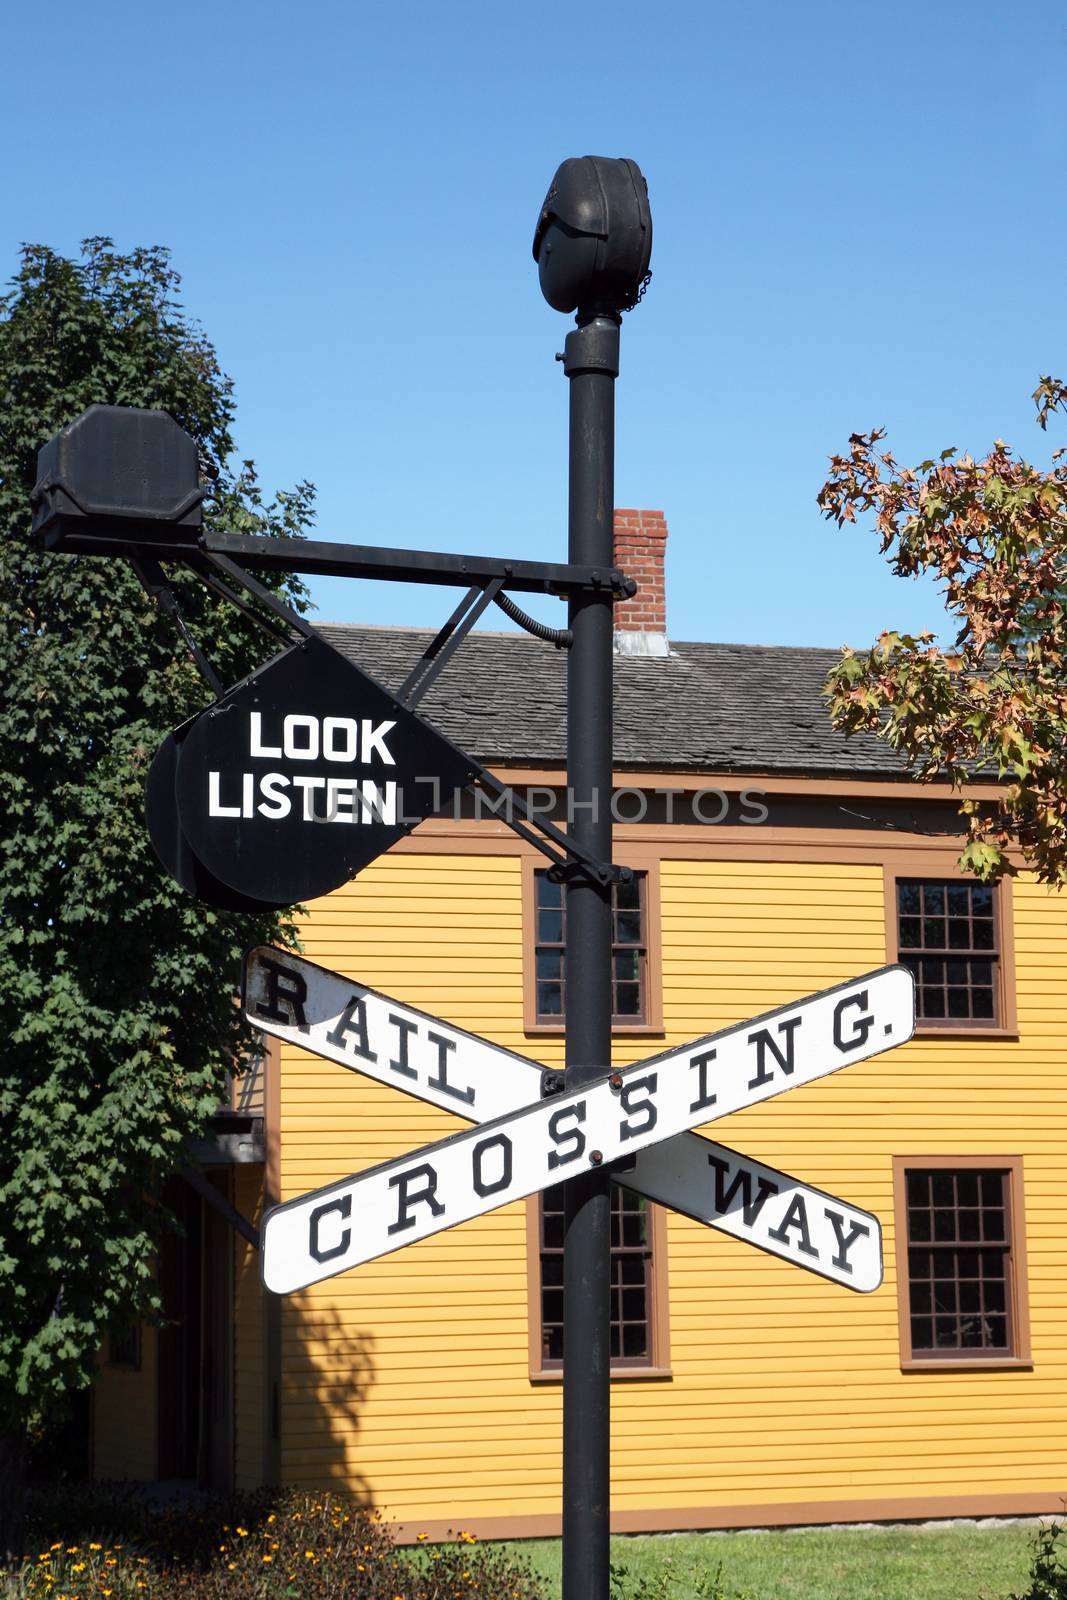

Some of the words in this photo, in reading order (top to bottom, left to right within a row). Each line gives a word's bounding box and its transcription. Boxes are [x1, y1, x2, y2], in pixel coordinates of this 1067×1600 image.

[250, 712, 397, 765] LOOK
[208, 771, 397, 826] LISTEN
[256, 957, 476, 1106] RAIL
[708, 1154, 870, 1274] WAY
